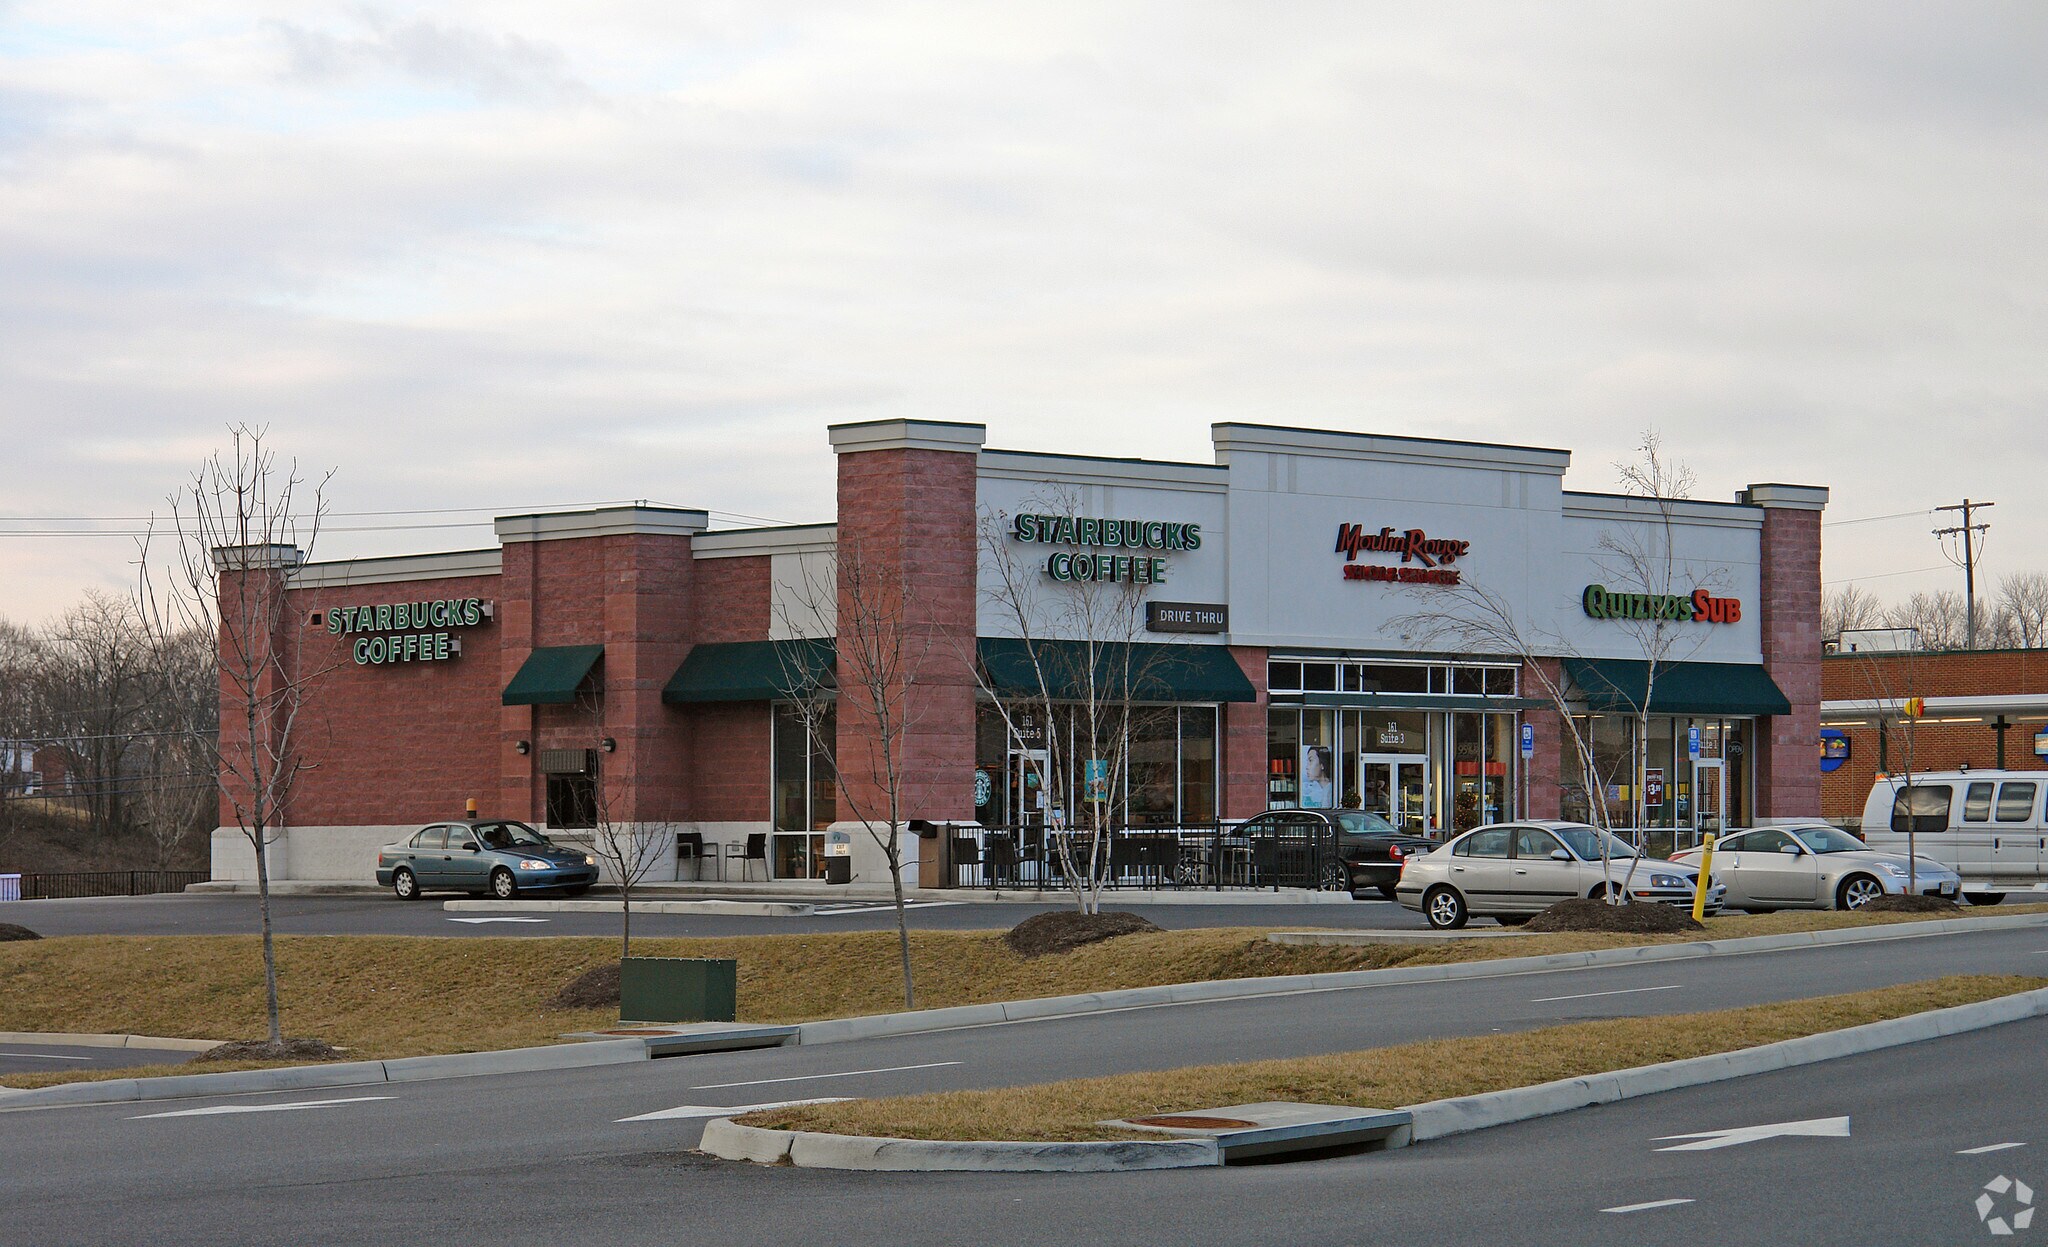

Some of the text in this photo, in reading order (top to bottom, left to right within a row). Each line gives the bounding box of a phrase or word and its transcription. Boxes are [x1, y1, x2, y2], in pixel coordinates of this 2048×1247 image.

[1016, 513, 1201, 551] STARBUCKS
[1335, 522, 1470, 567] Moulin Rouge
[1050, 552, 1167, 584] COFFEE
[327, 598, 480, 634] STARBUCKS
[1160, 609, 1224, 625] DRIVE THRU
[353, 632, 449, 665] COFFEE
[1036, 727, 1041, 739] 5
[1380, 732, 1405, 744] Suite 3
[1387, 721, 1397, 732] 161
[1728, 744, 1743, 753] OPEN
